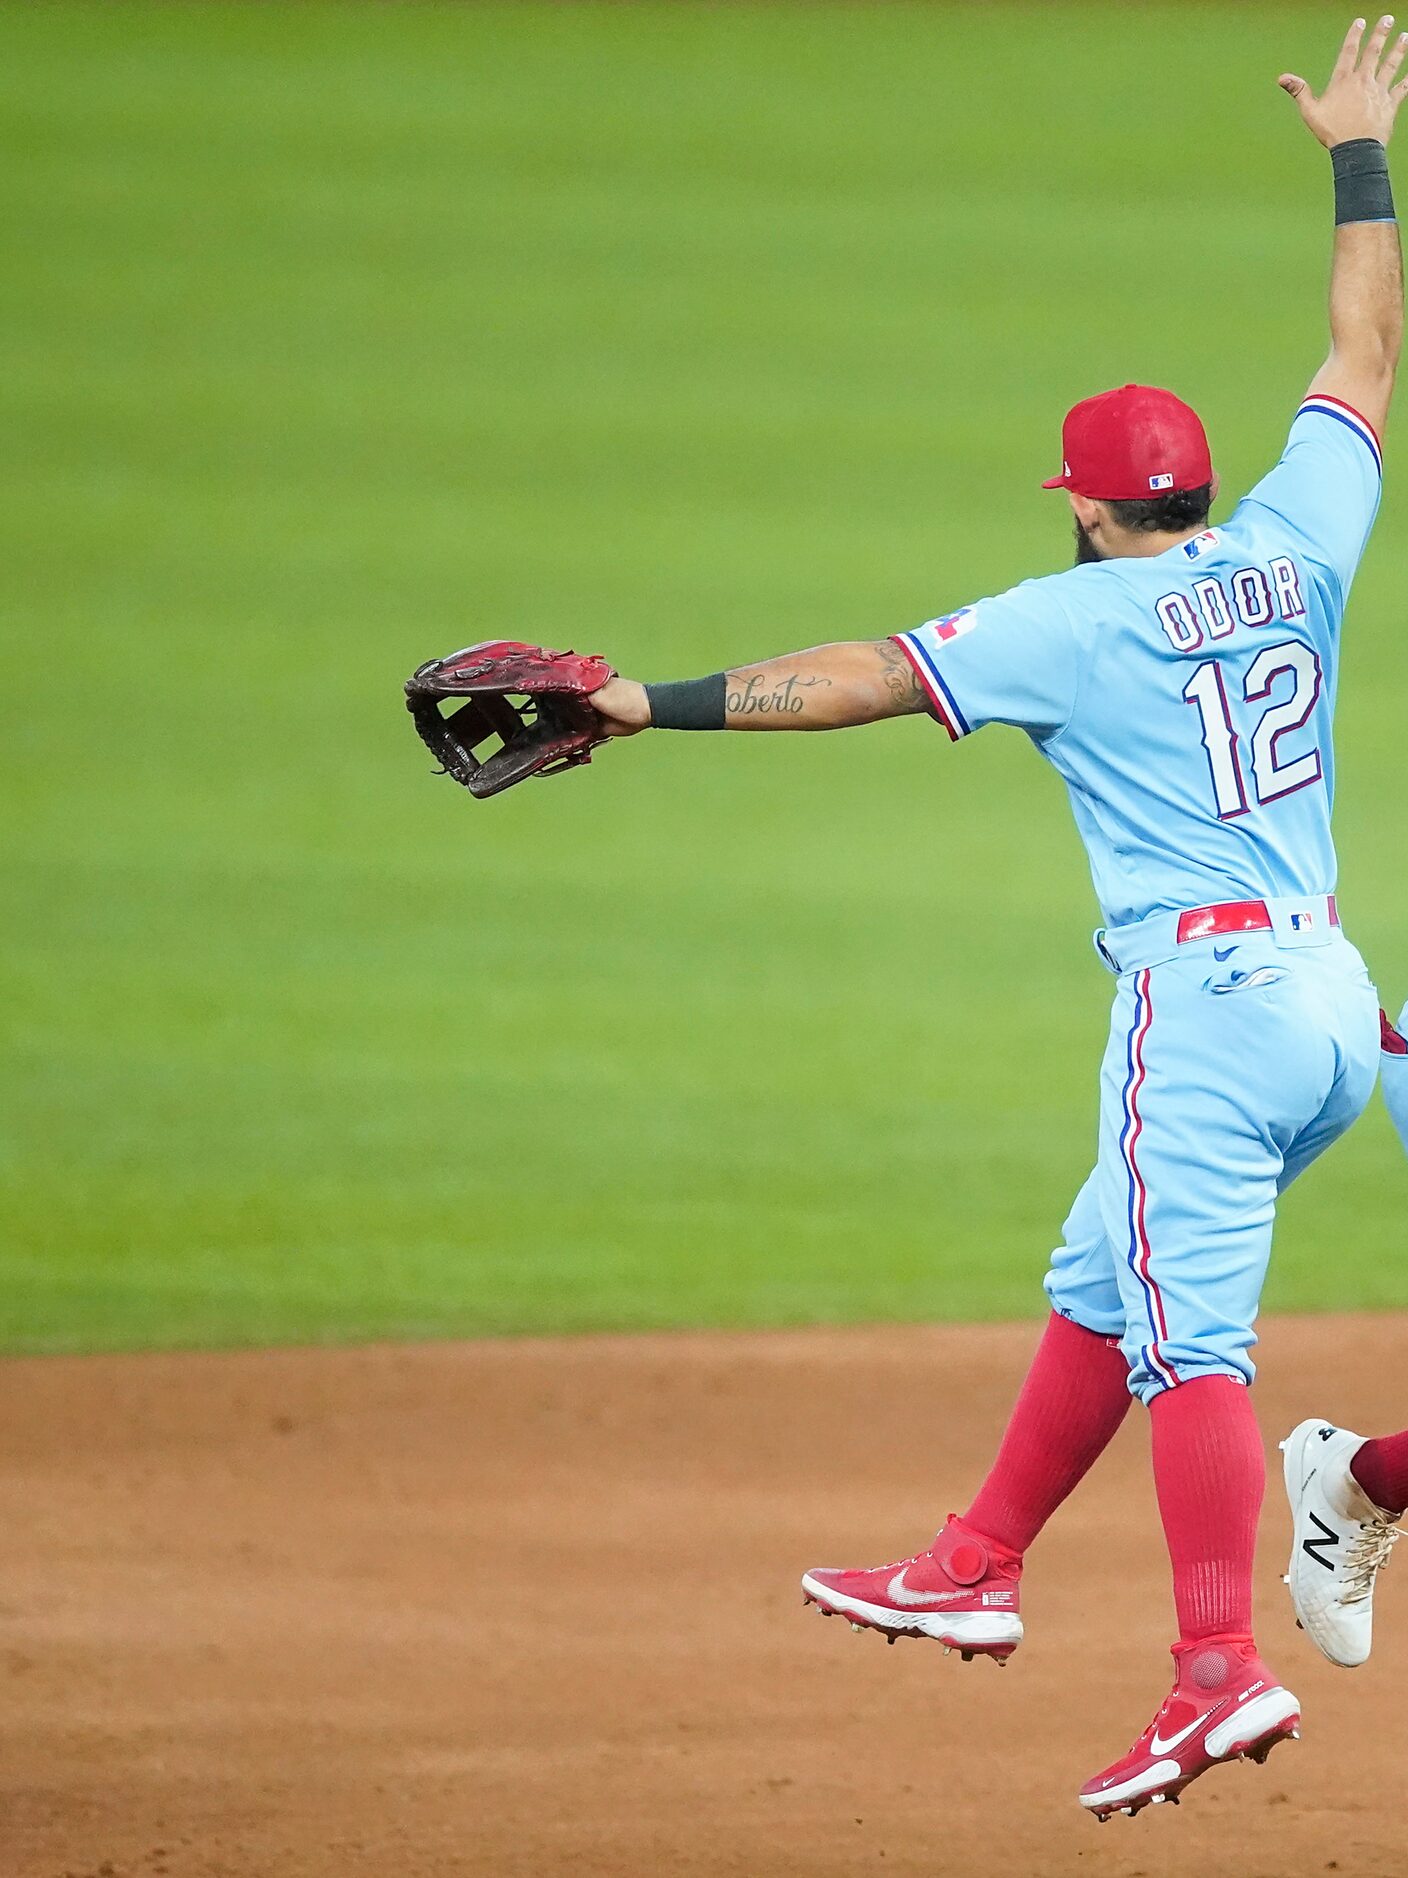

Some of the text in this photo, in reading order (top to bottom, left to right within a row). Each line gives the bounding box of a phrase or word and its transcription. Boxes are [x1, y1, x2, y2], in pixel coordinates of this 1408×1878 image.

[1155, 556, 1306, 653] ODOR
[726, 674, 832, 714] oberto
[1182, 639, 1323, 821] 12
